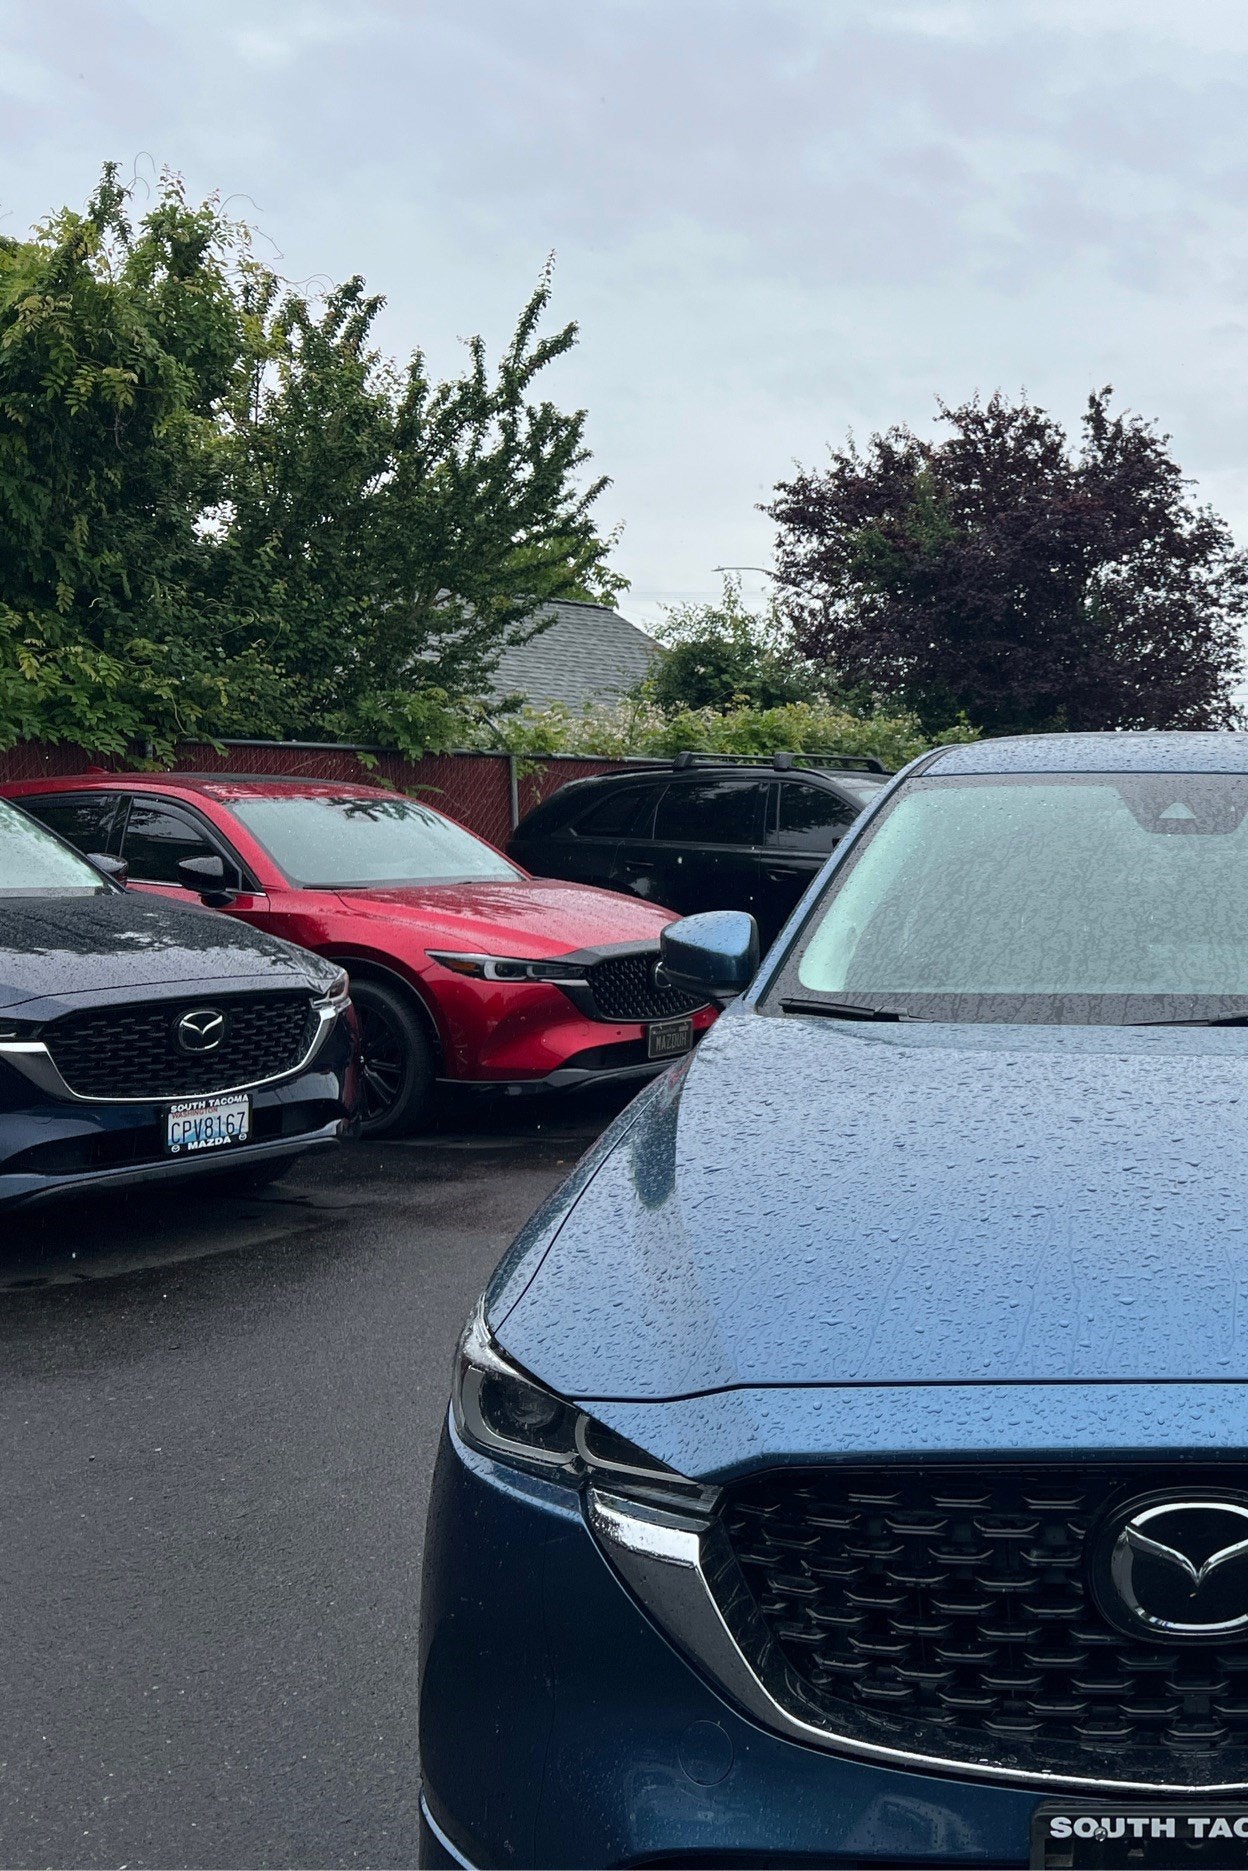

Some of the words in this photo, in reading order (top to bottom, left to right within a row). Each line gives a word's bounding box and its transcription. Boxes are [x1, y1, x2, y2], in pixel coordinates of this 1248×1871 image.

[170, 1101, 206, 1113] SOUTH
[209, 1094, 249, 1106] TACOMA
[172, 1106, 218, 1119] WASHINGTON
[171, 1112, 246, 1144] CPV8167
[187, 1135, 232, 1151] MAZDA
[1050, 1816, 1175, 1838] SOUTH
